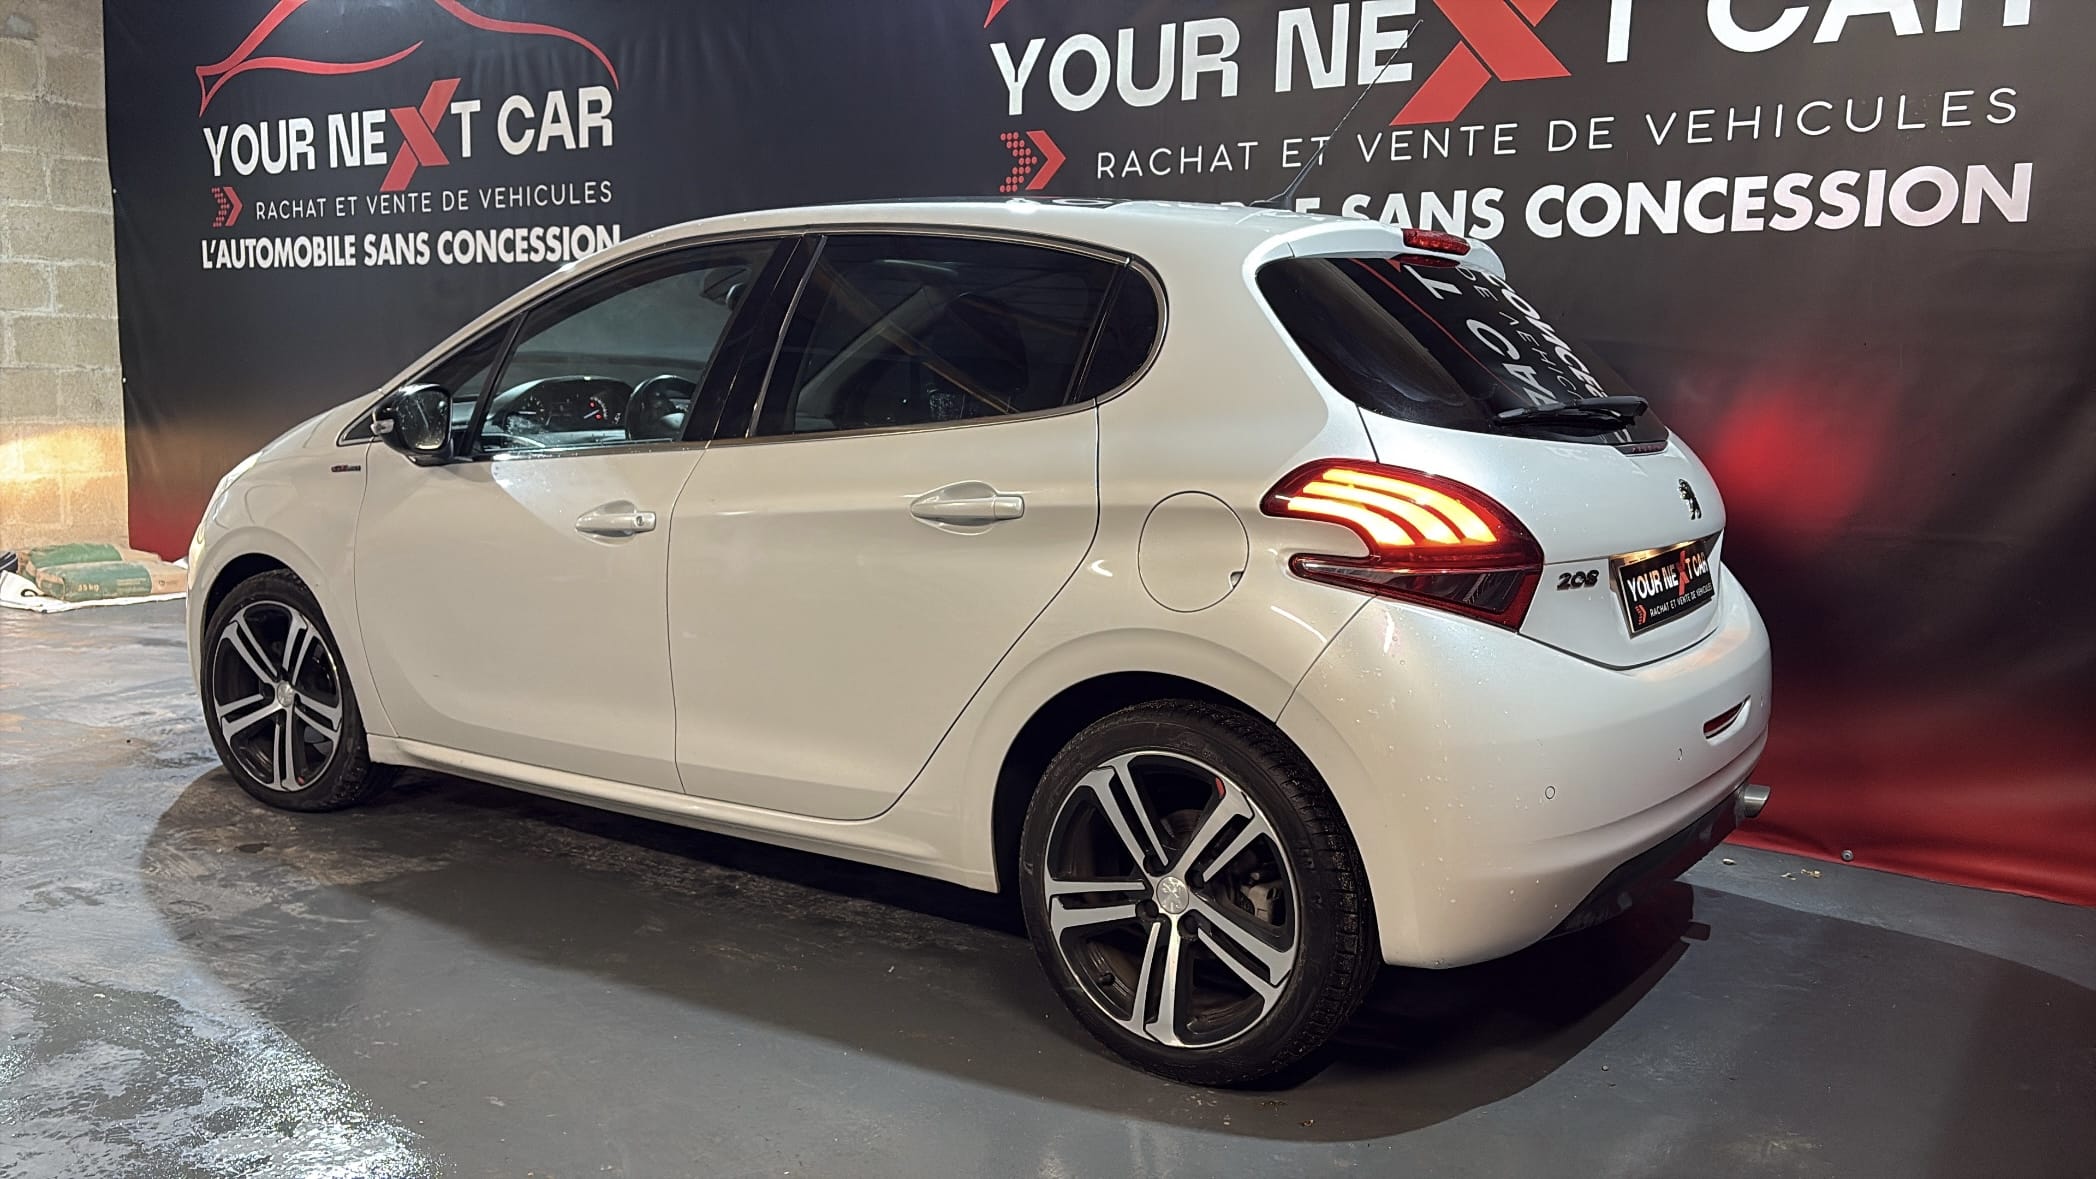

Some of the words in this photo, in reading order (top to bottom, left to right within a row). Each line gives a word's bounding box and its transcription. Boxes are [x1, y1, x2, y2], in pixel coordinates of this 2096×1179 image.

[990, 17, 1241, 116] YOUR
[203, 116, 315, 177] YOUR
[329, 77, 481, 191] NEXT
[497, 85, 613, 155] CAR
[1097, 141, 1259, 180] RACHAT
[1281, 136, 1332, 169] ET
[1357, 122, 1518, 163] VENTE
[1548, 116, 1615, 152] DE
[1645, 87, 2018, 146] VEHICULES
[256, 196, 327, 221] RACHAT
[336, 195, 358, 217] ET
[366, 192, 432, 216] VENTE
[442, 189, 470, 211] DE
[479, 180, 613, 208] VEHICULES
[1525, 162, 2034, 239] CONCESSION
[201, 233, 356, 270] L'AUTOMOBILE
[363, 231, 431, 267] SANS
[437, 223, 621, 265] CONCESSION
[1556, 568, 1600, 591] 208
[1627, 569, 1664, 602] YOUR
[1662, 550, 1693, 597] NEXT
[1692, 551, 1709, 577] CAR
[1649, 602, 1670, 617] RACHAT
[1670, 598, 1677, 610] ET
[1677, 594, 1691, 607] VENTE
[1690, 590, 1697, 601] DE
